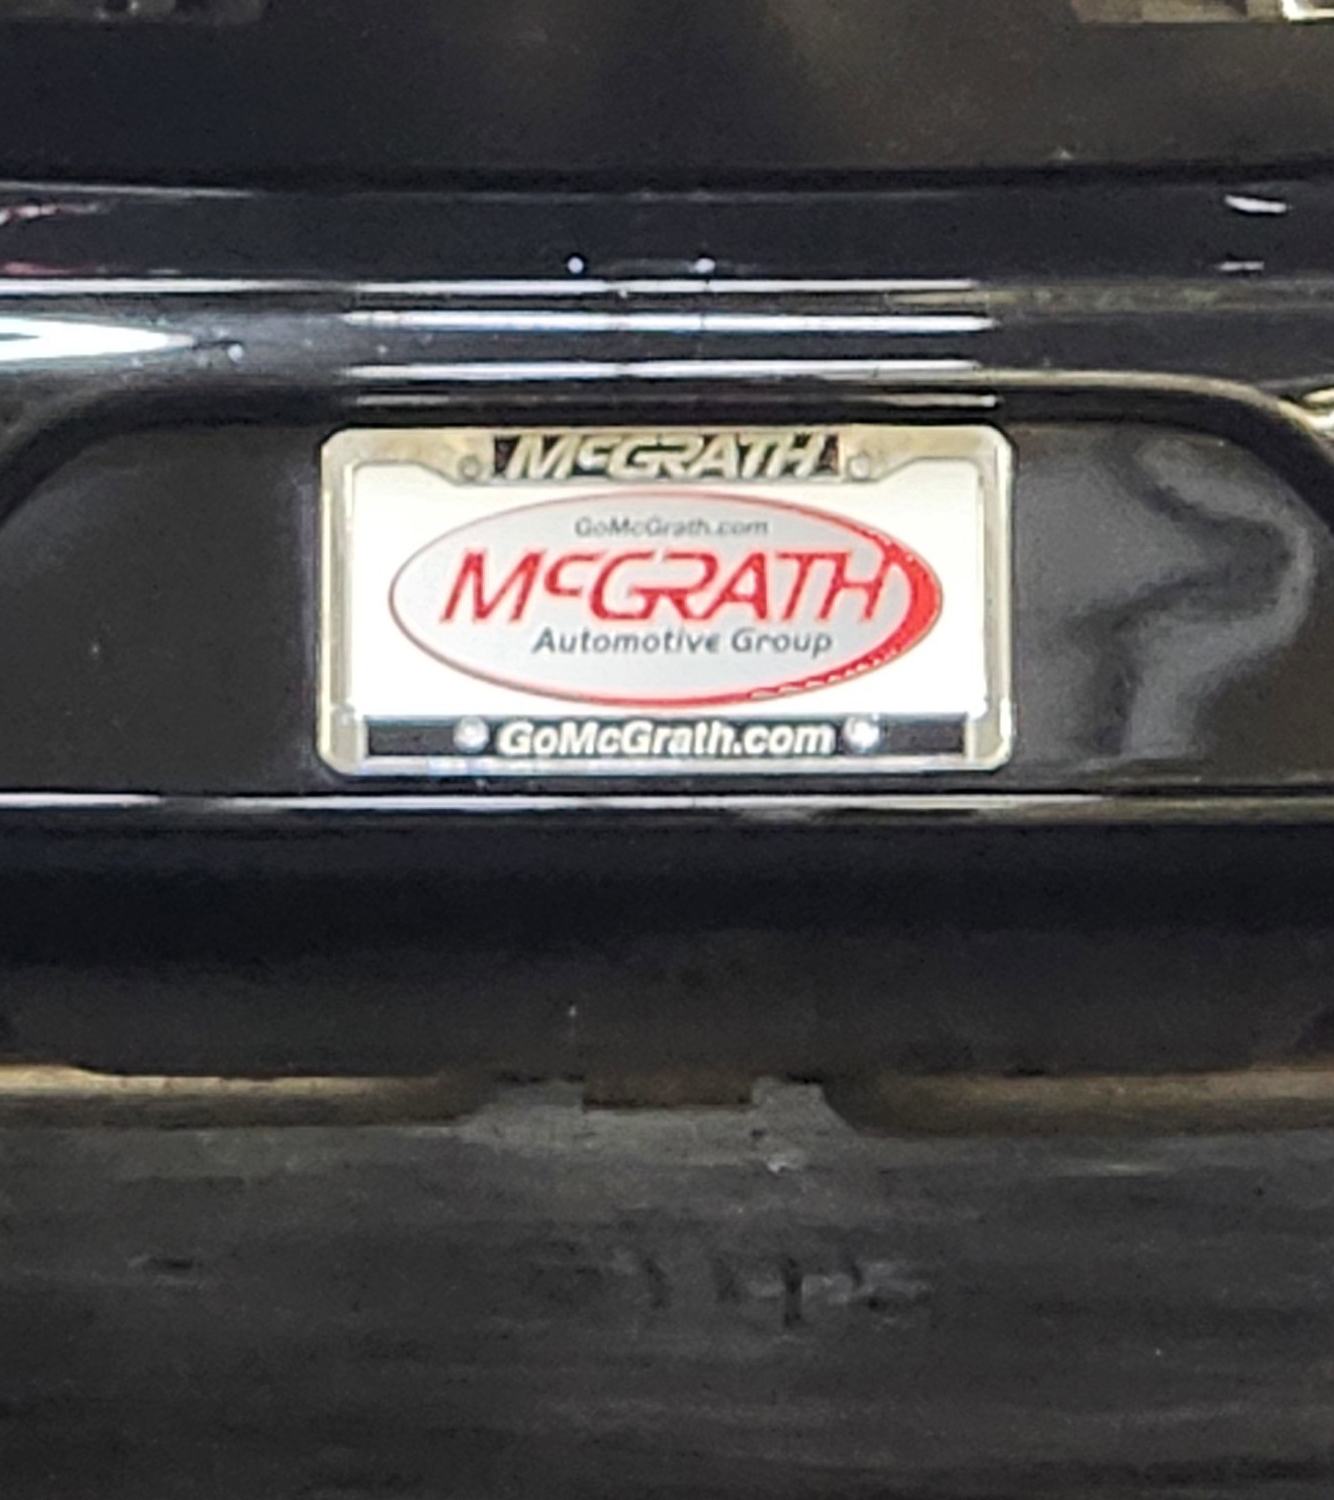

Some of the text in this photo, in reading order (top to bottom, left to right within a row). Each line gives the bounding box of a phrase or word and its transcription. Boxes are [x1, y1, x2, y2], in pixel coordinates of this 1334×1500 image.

[574, 516, 769, 539] GoMcGrath.com
[532, 627, 834, 660] Automotive Group
[496, 718, 835, 756] GoMcGrath.com
